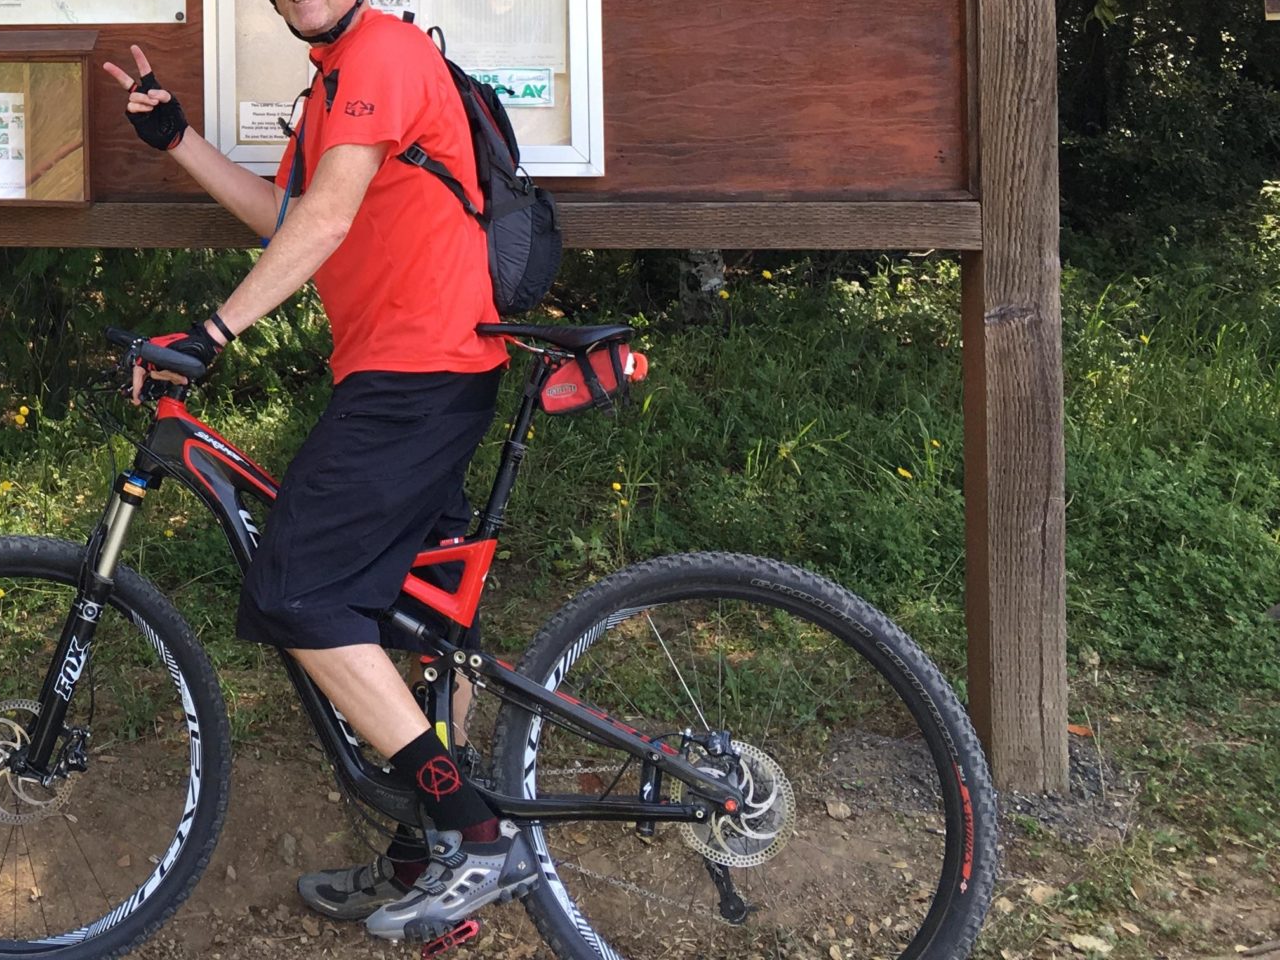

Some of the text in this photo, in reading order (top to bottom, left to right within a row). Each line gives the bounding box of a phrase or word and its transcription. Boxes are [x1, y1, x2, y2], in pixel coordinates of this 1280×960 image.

[54, 634, 92, 702] FOX
[750, 577, 874, 639] GROUND
[875, 640, 959, 758] CONTROL
